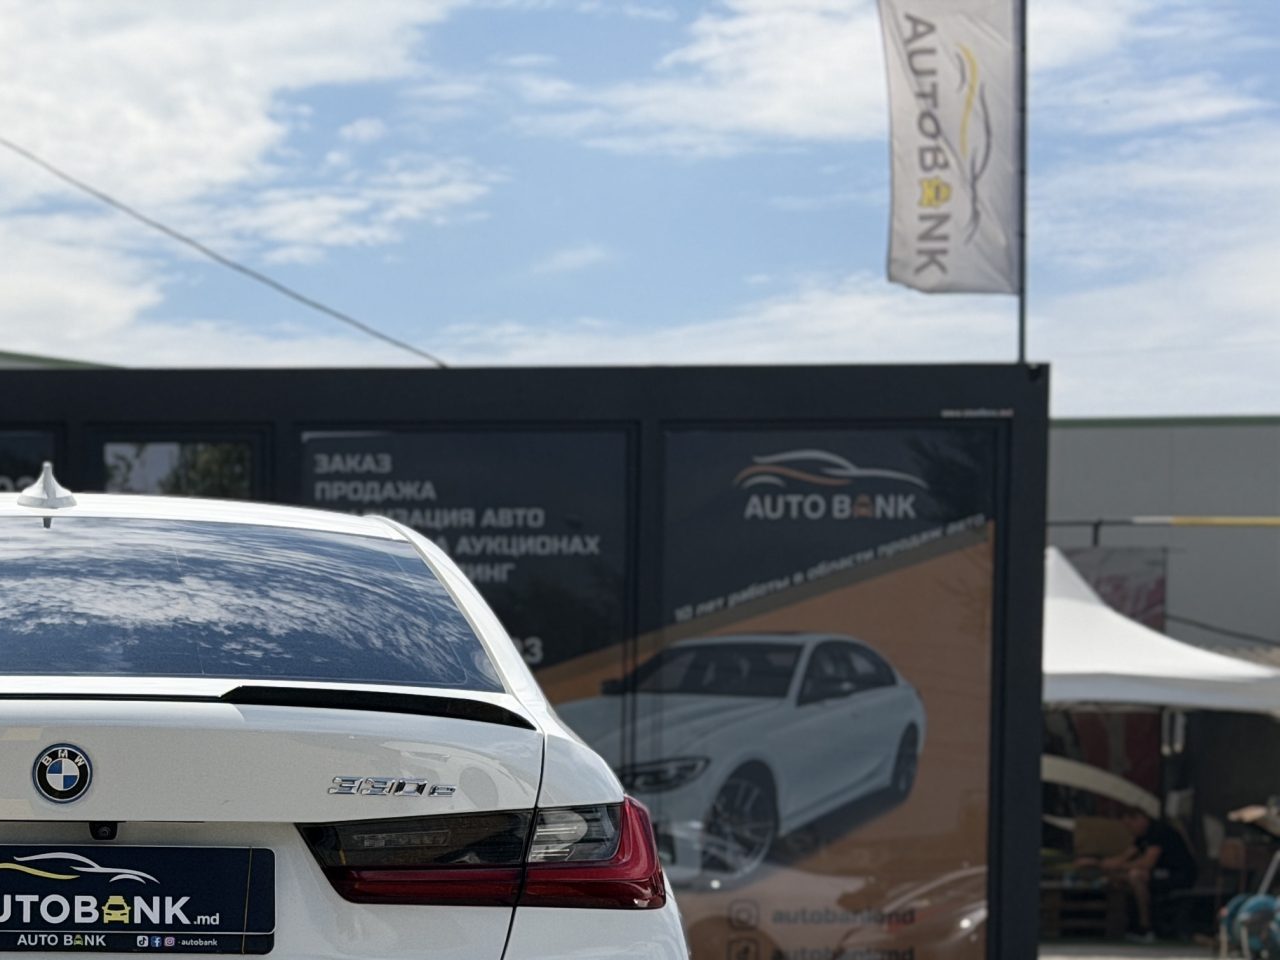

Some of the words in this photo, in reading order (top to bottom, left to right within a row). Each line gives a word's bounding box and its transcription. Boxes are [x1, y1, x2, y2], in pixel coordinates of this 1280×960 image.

[313, 453, 393, 474] ЗАКАЗ
[314, 480, 437, 504] ПРОДАЖА
[743, 493, 826, 520] AUTO
[480, 507, 545, 529] АВТО
[455, 534, 600, 557] АУКЦИОНАХ
[41, 749, 85, 767] BMW
[17, 934, 58, 946] AUTO
